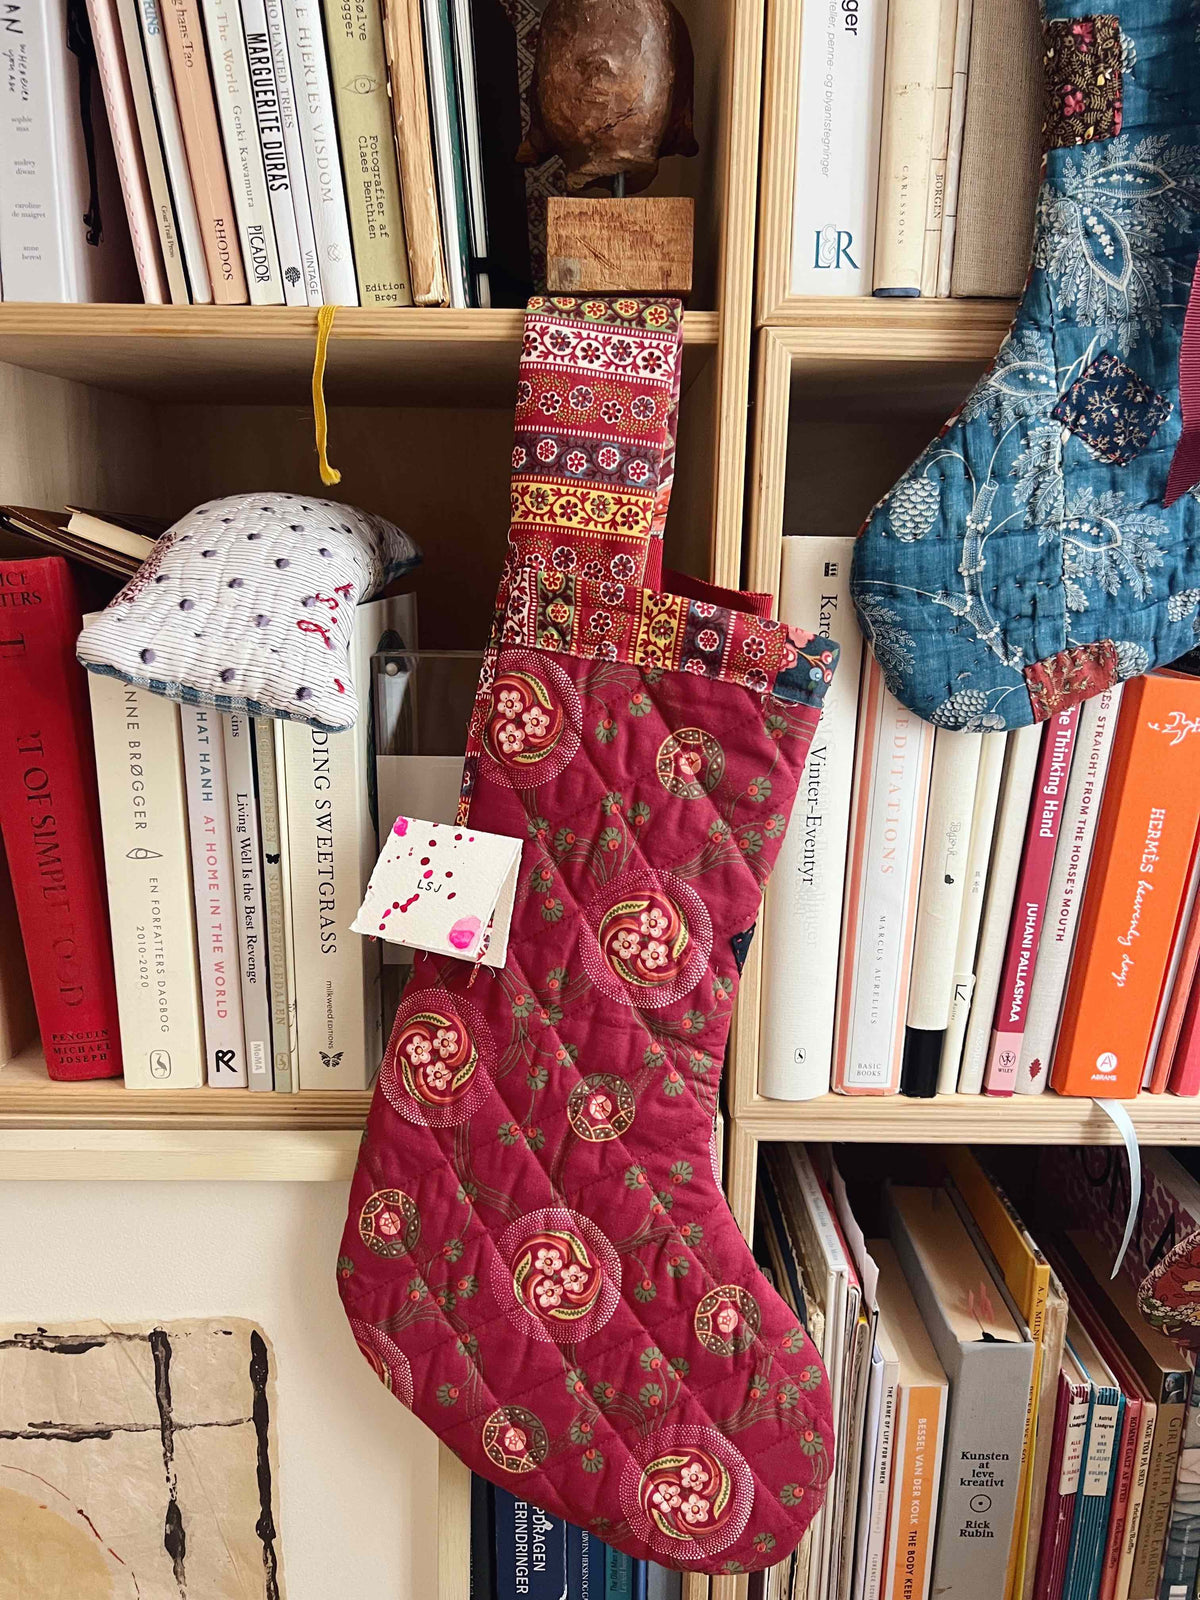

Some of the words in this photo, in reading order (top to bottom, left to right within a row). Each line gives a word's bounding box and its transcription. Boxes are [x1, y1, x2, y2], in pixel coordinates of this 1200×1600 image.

[176, 9, 189, 39] hans
[217, 12, 229, 41] The
[340, 0, 354, 38] gger
[182, 42, 194, 68] Tao
[223, 49, 240, 94] World
[246, 32, 281, 135] MARGUERITE
[270, 23, 288, 84] PLANTED
[279, 88, 295, 129] TREES
[823, 73, 833, 91] og
[232, 104, 245, 142] Genki
[820, 92, 835, 178] blyantstegninger
[262, 140, 290, 192] DURAS
[312, 121, 334, 203] VISDOM
[358, 136, 370, 174] Claes
[238, 146, 255, 208] Kawamura
[368, 135, 386, 217] Fotografier
[378, 227, 390, 239] af
[363, 180, 376, 240] Benthien
[933, 174, 944, 219] BORGEN
[213, 218, 234, 281] RHODOS
[247, 224, 270, 284] PICADOR
[304, 250, 320, 295] VINTAGE
[365, 281, 406, 292] Edition
[123, 683, 140, 730] NNE
[1100, 689, 1113, 710] ES
[311, 728, 331, 791] DING
[1043, 728, 1071, 796] Thinking
[1087, 715, 1107, 778] STRAIGHT
[23, 766, 54, 807] OF
[128, 740, 148, 830] BRØGGER
[199, 753, 214, 802] HANH
[880, 705, 910, 875] EDITATIONS
[236, 793, 248, 833] Living
[1079, 781, 1094, 816] FROM
[203, 815, 216, 834] AT
[797, 746, 828, 886] Vinter-Eventyr
[1039, 800, 1060, 838] Hand
[1074, 819, 1087, 842] THE
[205, 842, 220, 891] HOME
[240, 837, 253, 864] Well
[149, 877, 159, 893] EN
[242, 866, 253, 879] Is
[314, 799, 337, 955] SWEETGRASS
[416, 879, 443, 894] LSJ
[1064, 844, 1082, 896] HORSE'S
[209, 899, 221, 915] IN
[243, 882, 252, 901] the
[244, 905, 256, 930] Best
[1019, 901, 1039, 949] JUHANI
[1055, 898, 1072, 942] MOUTH
[1117, 879, 1154, 947] heavenly
[150, 900, 166, 975] FORFATTERS
[211, 923, 223, 954] THE
[876, 914, 887, 961] MARCUS
[136, 926, 149, 989] 2010-2020
[246, 934, 258, 984] Revenge
[1111, 953, 1136, 988] days
[213, 961, 228, 1019] WORLD
[870, 968, 882, 1025] AURELIUS
[1009, 950, 1032, 1023] PALLASMAA
[157, 980, 170, 1033] DAGBOG
[52, 1028, 109, 1042] PENGUIN
[59, 1053, 108, 1064] JOSEPH
[253, 1043, 262, 1072] MoMA
[856, 1069, 882, 1077] BOOKS
[857, 1062, 882, 1070] BASIC
[1090, 1073, 1118, 1082] ABRAMS
[884, 1420, 890, 1431] OF
[885, 1401, 893, 1419] GAME
[915, 1418, 927, 1452] BESSEL
[1128, 1416, 1138, 1444] KOMME
[1144, 1418, 1154, 1438] TAGE
[1167, 1417, 1182, 1450] GIRL
[960, 1451, 1010, 1461] Kunsten
[1125, 1445, 1135, 1468] GALT
[1142, 1439, 1151, 1451] TØJ
[879, 1463, 887, 1485] WOMEN
[913, 1453, 925, 1476] VAN
[971, 1469, 995, 1479] leve
[978, 1462, 990, 1470] at
[1123, 1470, 1130, 1482] AF
[1137, 1466, 1147, 1487] SELV
[1163, 1450, 1178, 1486] WITH
[911, 1479, 923, 1497] DER
[959, 1477, 1005, 1487] kreativt
[1119, 1483, 1129, 1503] STED
[909, 1500, 921, 1525] KOLK
[965, 1519, 991, 1530] Rick
[1153, 1501, 1170, 1534] PEARL
[514, 1501, 530, 1595] ERINDRINGER
[906, 1530, 918, 1547] THE
[958, 1528, 995, 1539] Rubin
[581, 1554, 589, 1580] HEKSEN
[905, 1550, 916, 1576] BODY
[1144, 1539, 1164, 1588] EARRING
[581, 1580, 589, 1592] OG
